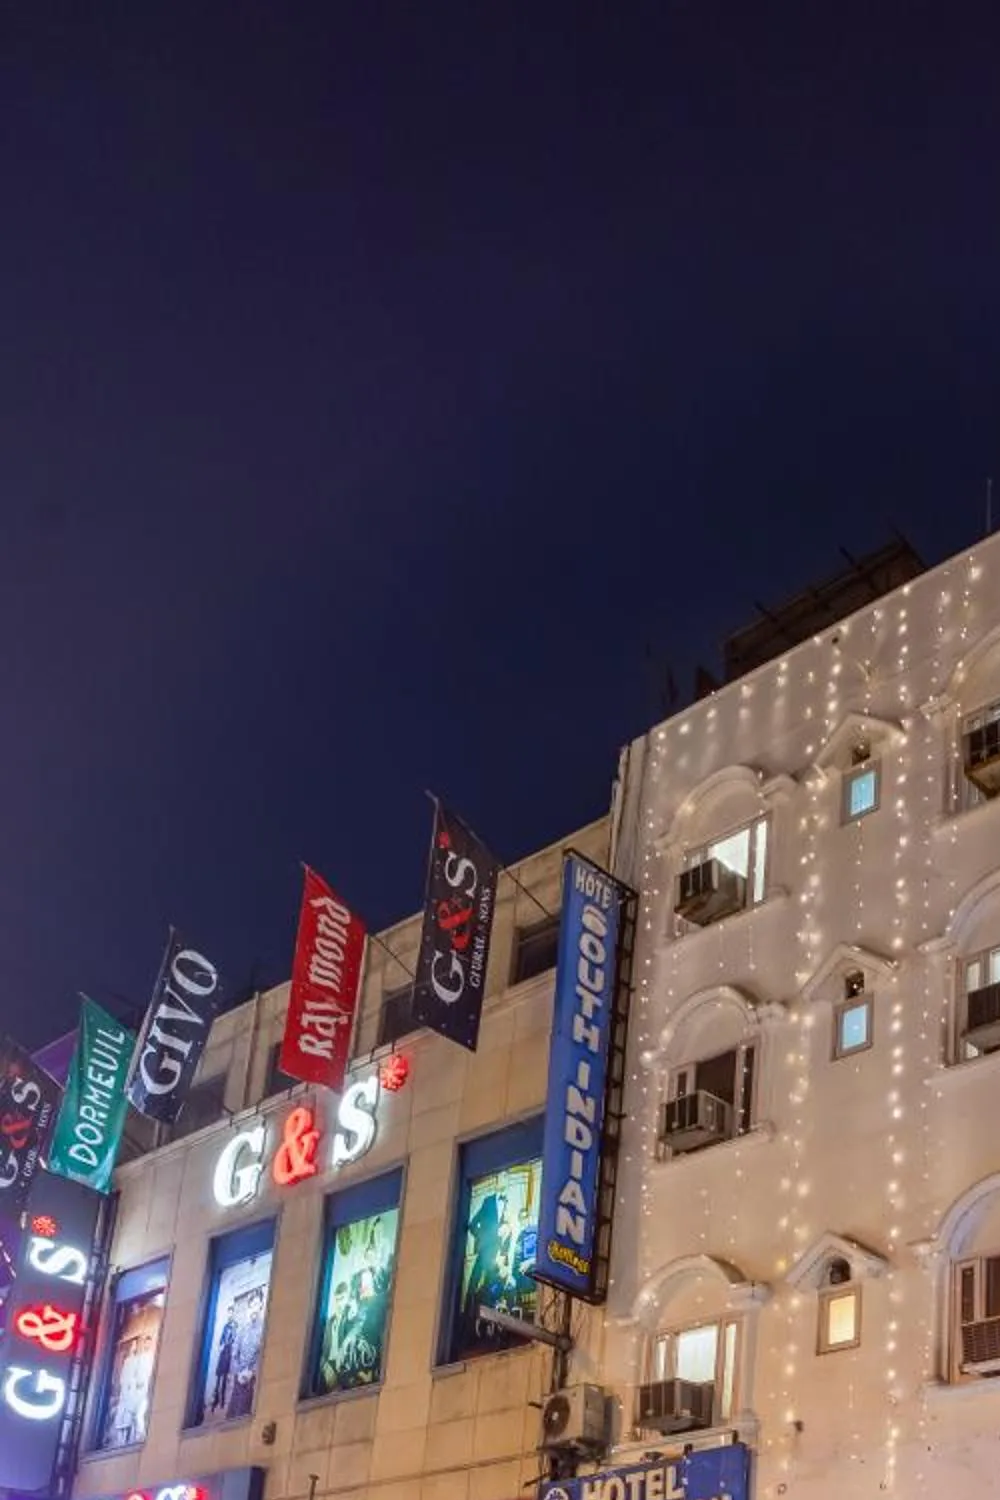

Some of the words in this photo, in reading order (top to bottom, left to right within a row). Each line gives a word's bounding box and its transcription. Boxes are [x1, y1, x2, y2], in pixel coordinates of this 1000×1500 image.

[575, 866, 614, 909] HOTE
[140, 950, 218, 1095] GIVO
[68, 1028, 125, 1167] DORMEUIL
[556, 1061, 596, 1245] INDIAN
